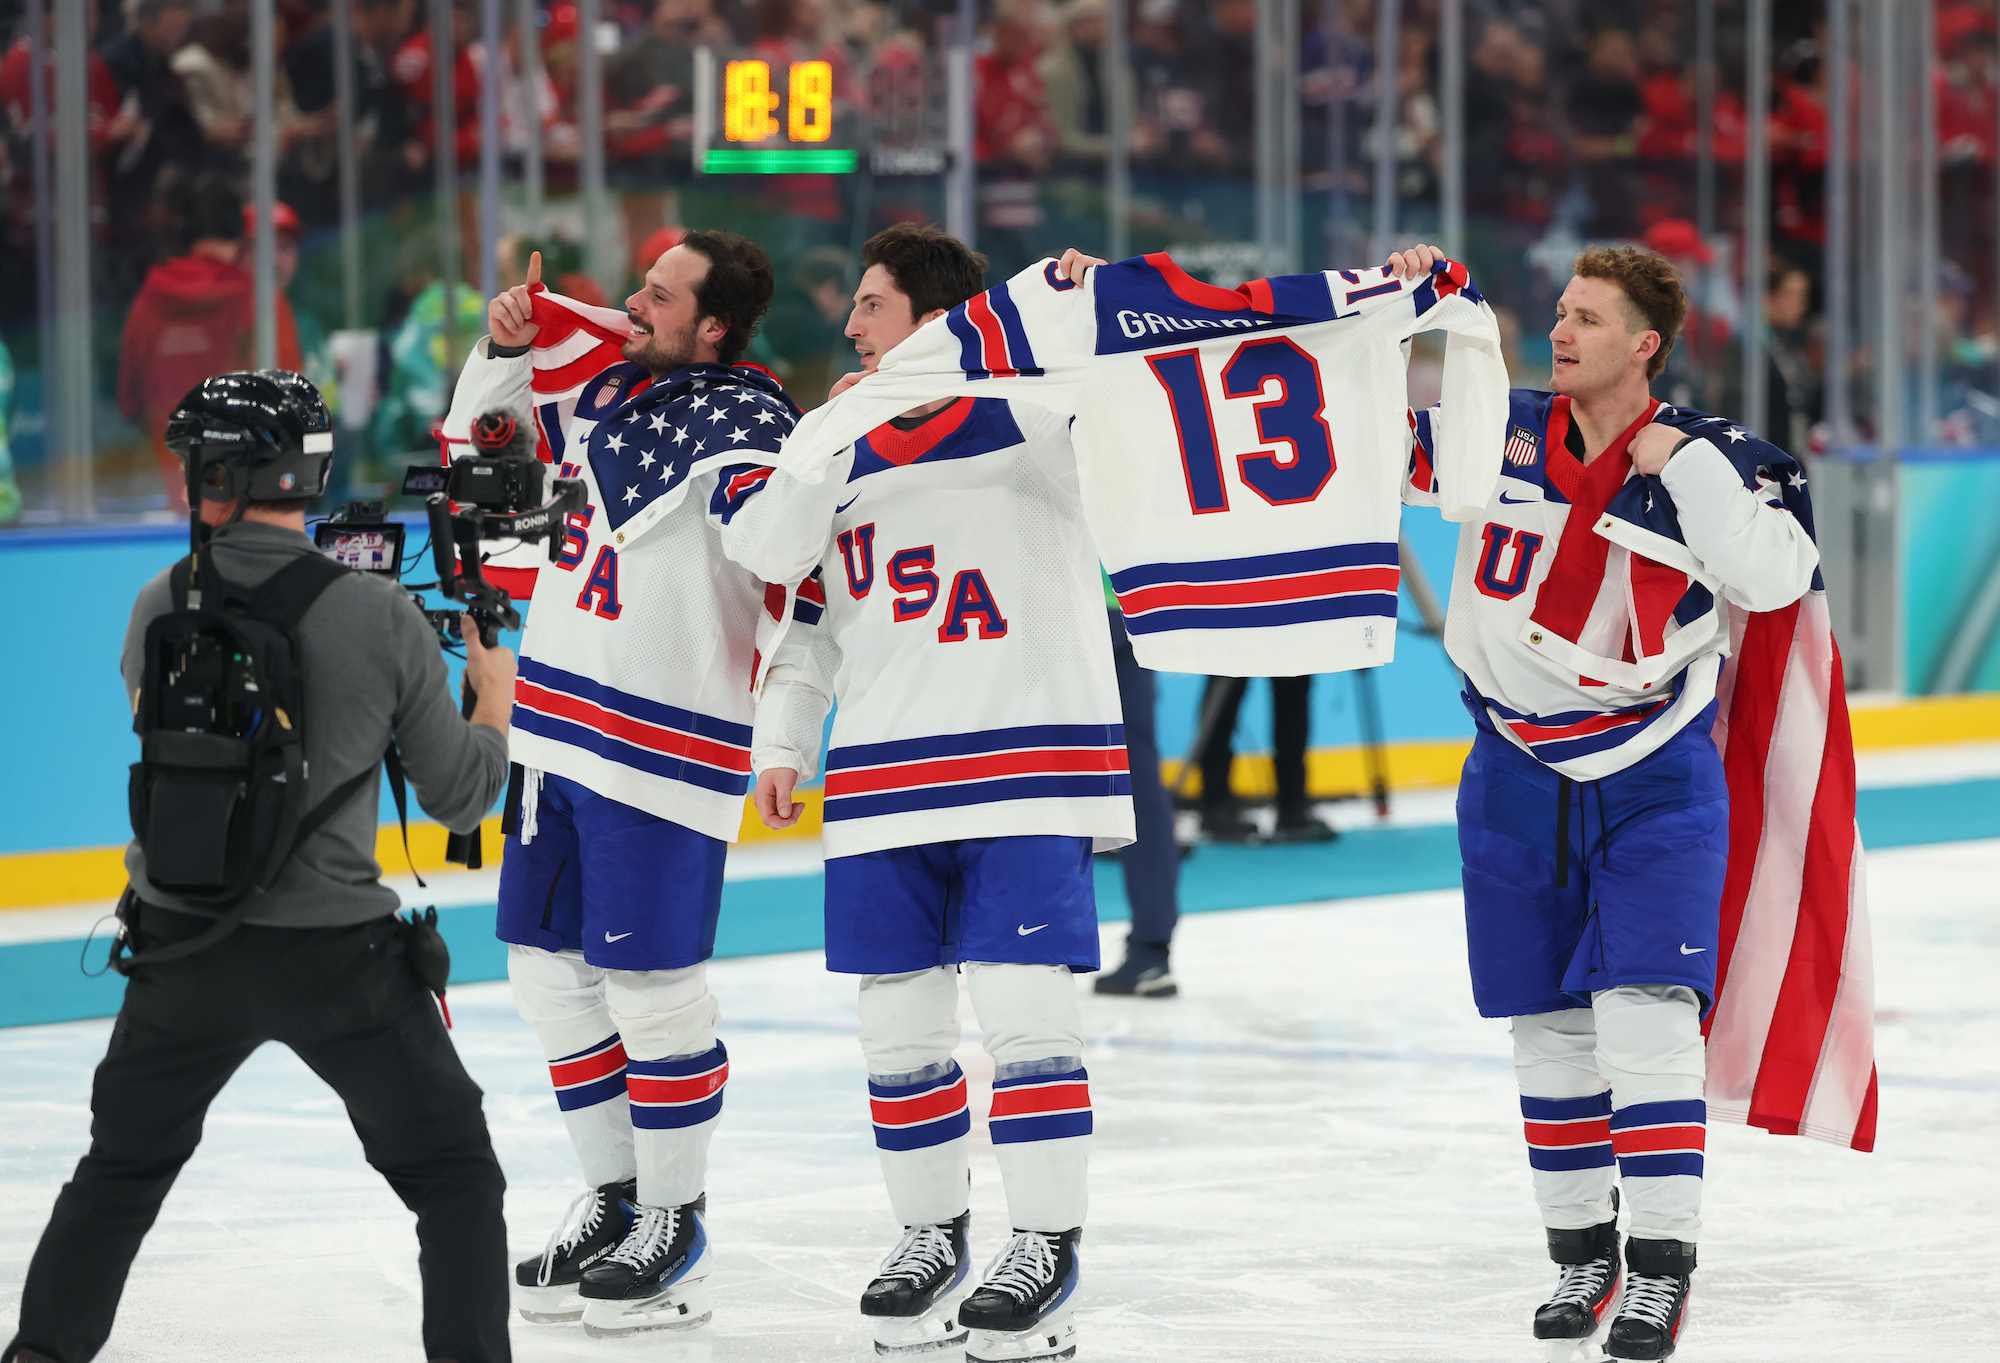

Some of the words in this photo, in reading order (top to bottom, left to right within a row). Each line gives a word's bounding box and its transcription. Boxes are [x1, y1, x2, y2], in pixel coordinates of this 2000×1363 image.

[608, 378, 621, 386] USA
[203, 430, 241, 441] BAUER
[1144, 335, 1338, 515] 13
[1516, 428, 1535, 444] USA
[515, 513, 549, 531] RONIN
[556, 462, 623, 621] SA
[837, 522, 1007, 643] USA
[578, 1242, 616, 1270] BAUER
[658, 1255, 686, 1282] BAUER
